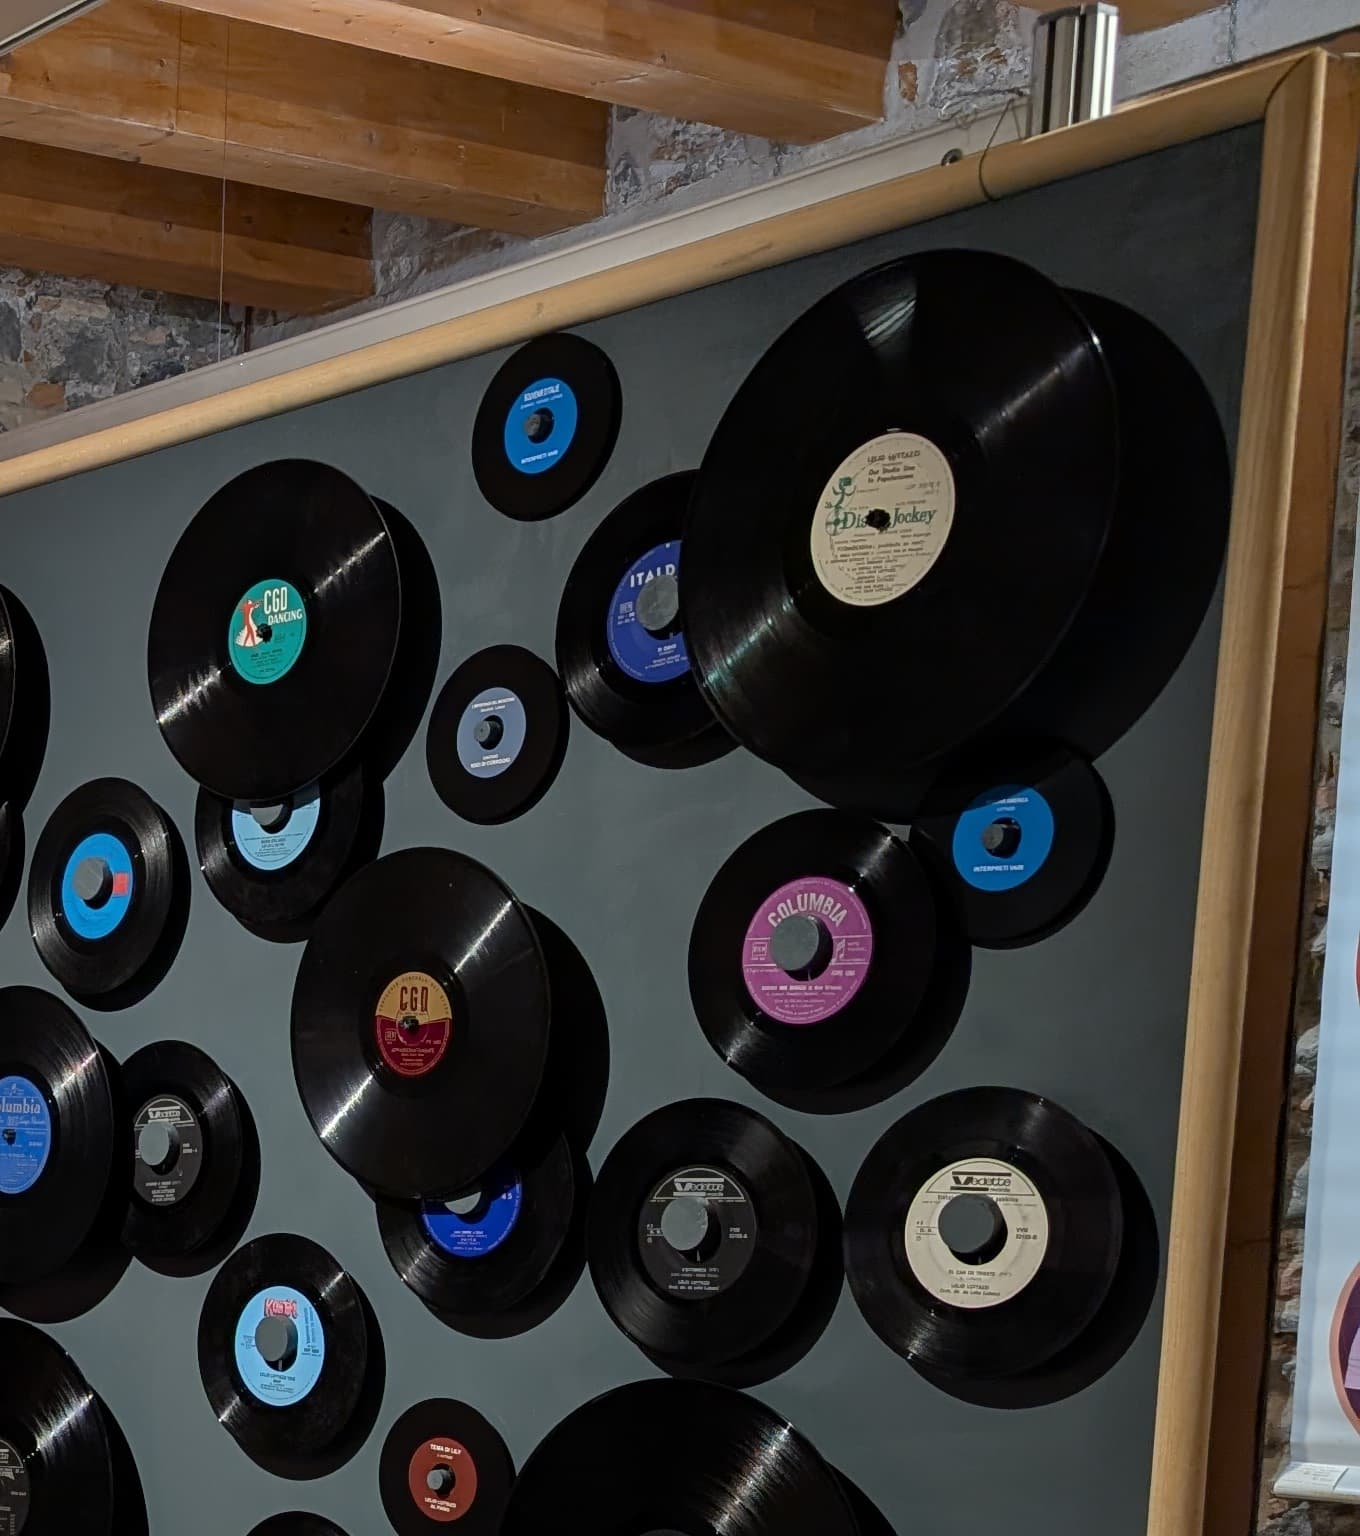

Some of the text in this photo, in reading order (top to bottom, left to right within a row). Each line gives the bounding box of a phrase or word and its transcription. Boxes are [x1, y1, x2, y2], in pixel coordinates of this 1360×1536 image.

[891, 506, 937, 528] Jockey
[264, 587, 288, 614] CGD
[268, 608, 303, 625] DANCING
[768, 893, 847, 927] COLUMBIA
[952, 1175, 1012, 1187] Vedette
